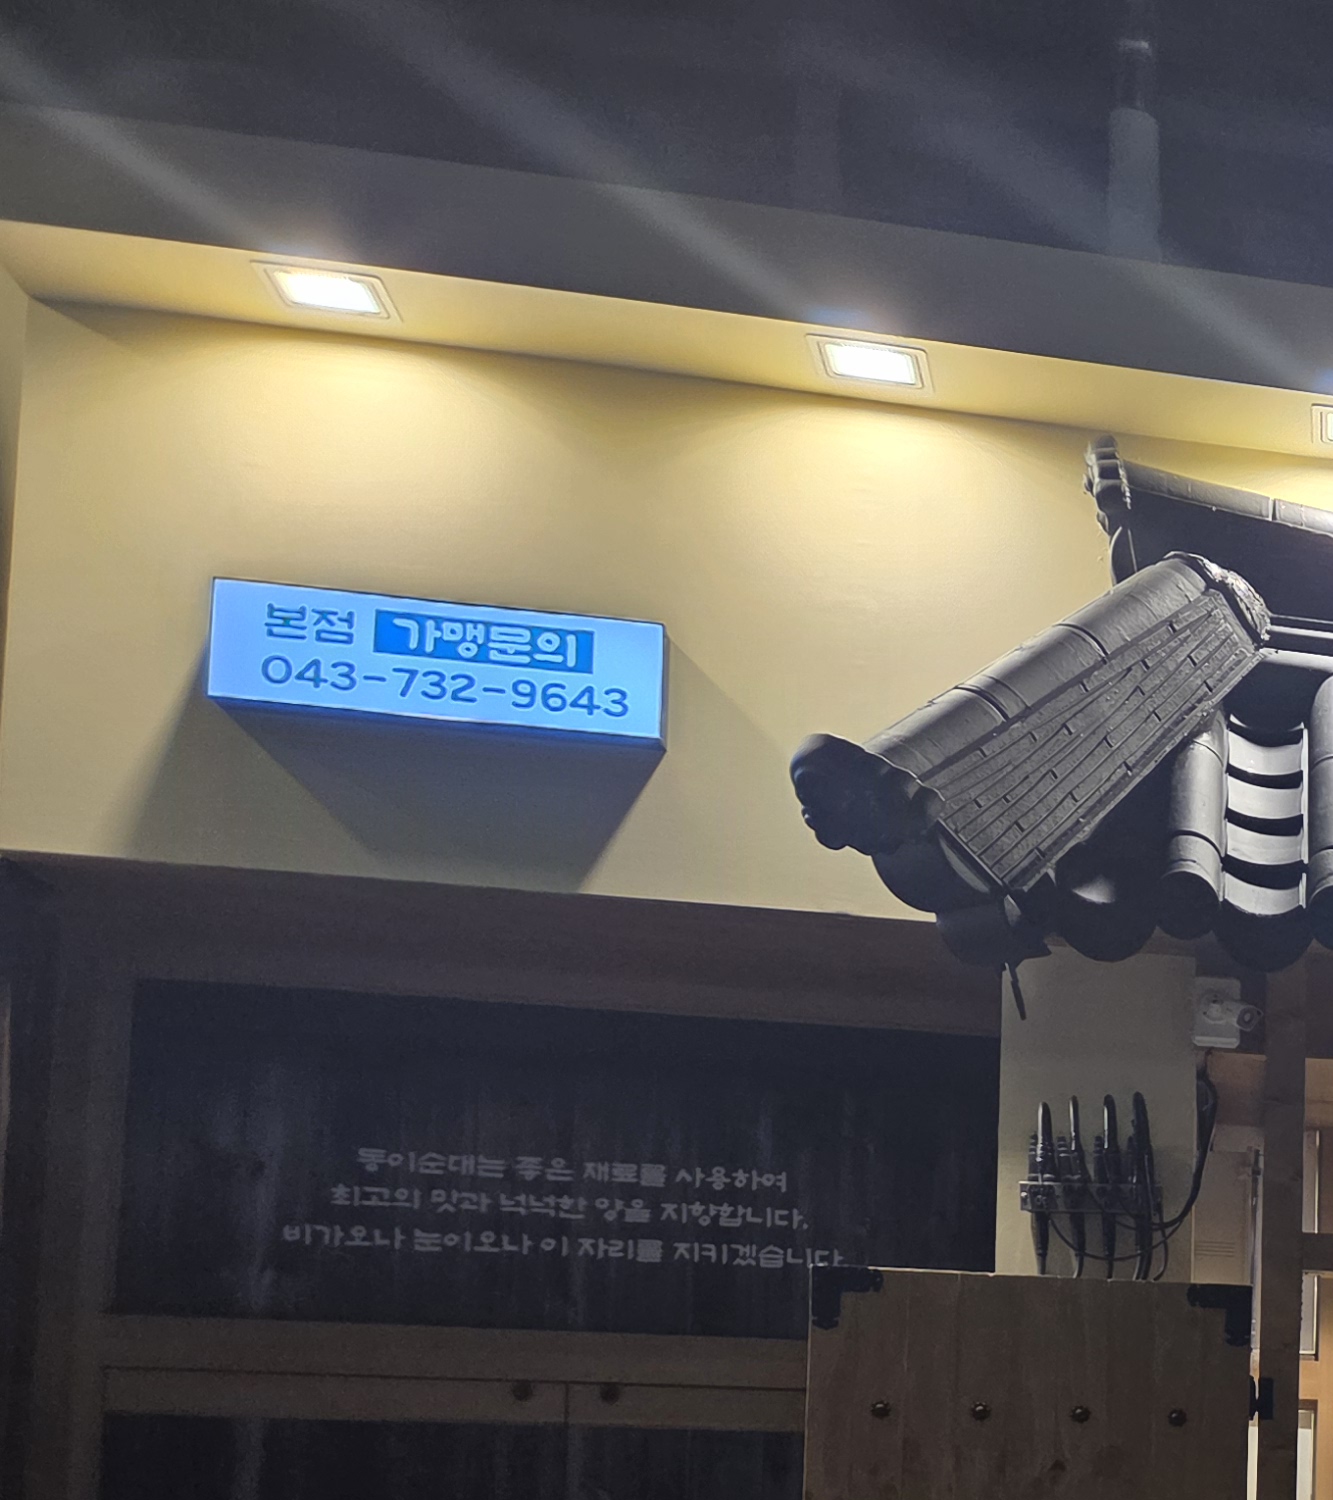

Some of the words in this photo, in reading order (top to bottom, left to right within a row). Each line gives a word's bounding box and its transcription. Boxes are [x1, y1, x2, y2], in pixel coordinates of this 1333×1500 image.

[264, 603, 355, 645] 본점
[393, 617, 577, 668] 가맹문의
[261, 655, 630, 718] 043-732-9643
[356, 1146, 506, 1179] 동이순대는
[514, 1154, 574, 1182] 좋은
[582, 1160, 667, 1188] 재료를
[675, 1165, 788, 1193] 사용하여
[330, 1183, 422, 1209] 최고의
[430, 1188, 492, 1213] 맛과
[499, 1193, 588, 1220] 넉넉한
[594, 1197, 652, 1224] 양을
[660, 1201, 809, 1230] 지향합니다.
[540, 1236, 568, 1258] 이
[577, 1238, 664, 1264] 자리를
